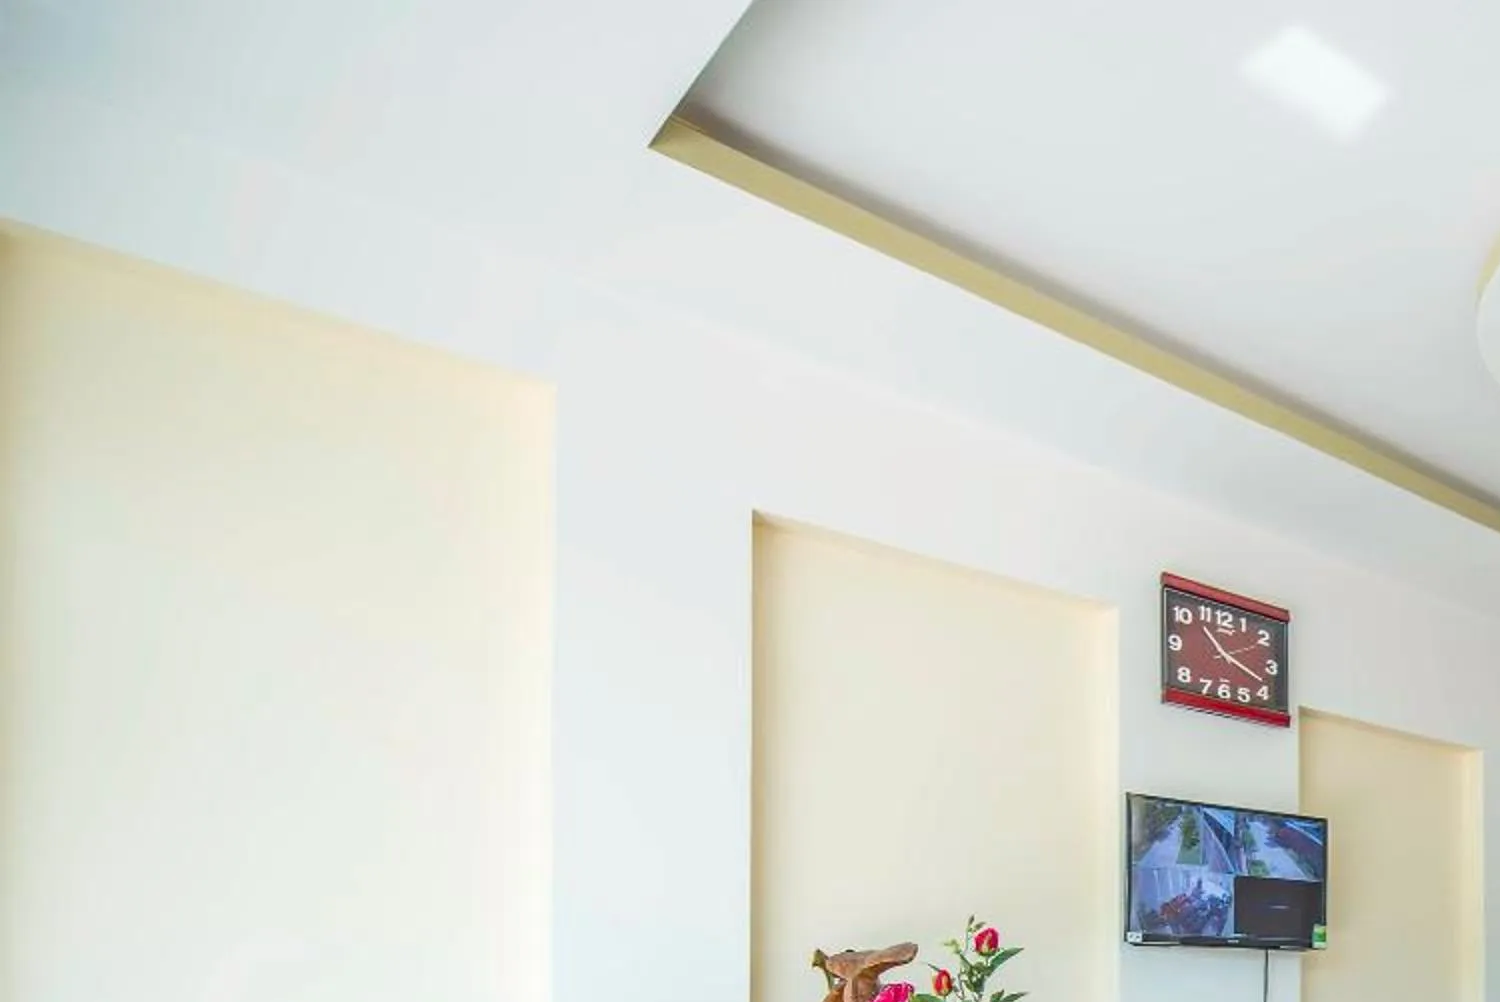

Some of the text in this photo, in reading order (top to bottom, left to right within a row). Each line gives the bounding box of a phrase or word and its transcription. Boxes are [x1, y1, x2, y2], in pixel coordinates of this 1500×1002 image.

[1173, 606, 1192, 624] 10
[1199, 606, 1211, 622] 11
[1215, 610, 1235, 628] 12
[1239, 617, 1247, 632] 1
[1168, 635, 1183, 651] 9
[1257, 630, 1271, 646] 2
[1177, 667, 1191, 683] 8
[1265, 660, 1278, 675] 3
[1199, 678, 1212, 695] 7
[1217, 684, 1231, 699] 6
[1256, 685, 1269, 700] 4
[1237, 687, 1250, 703] 5
